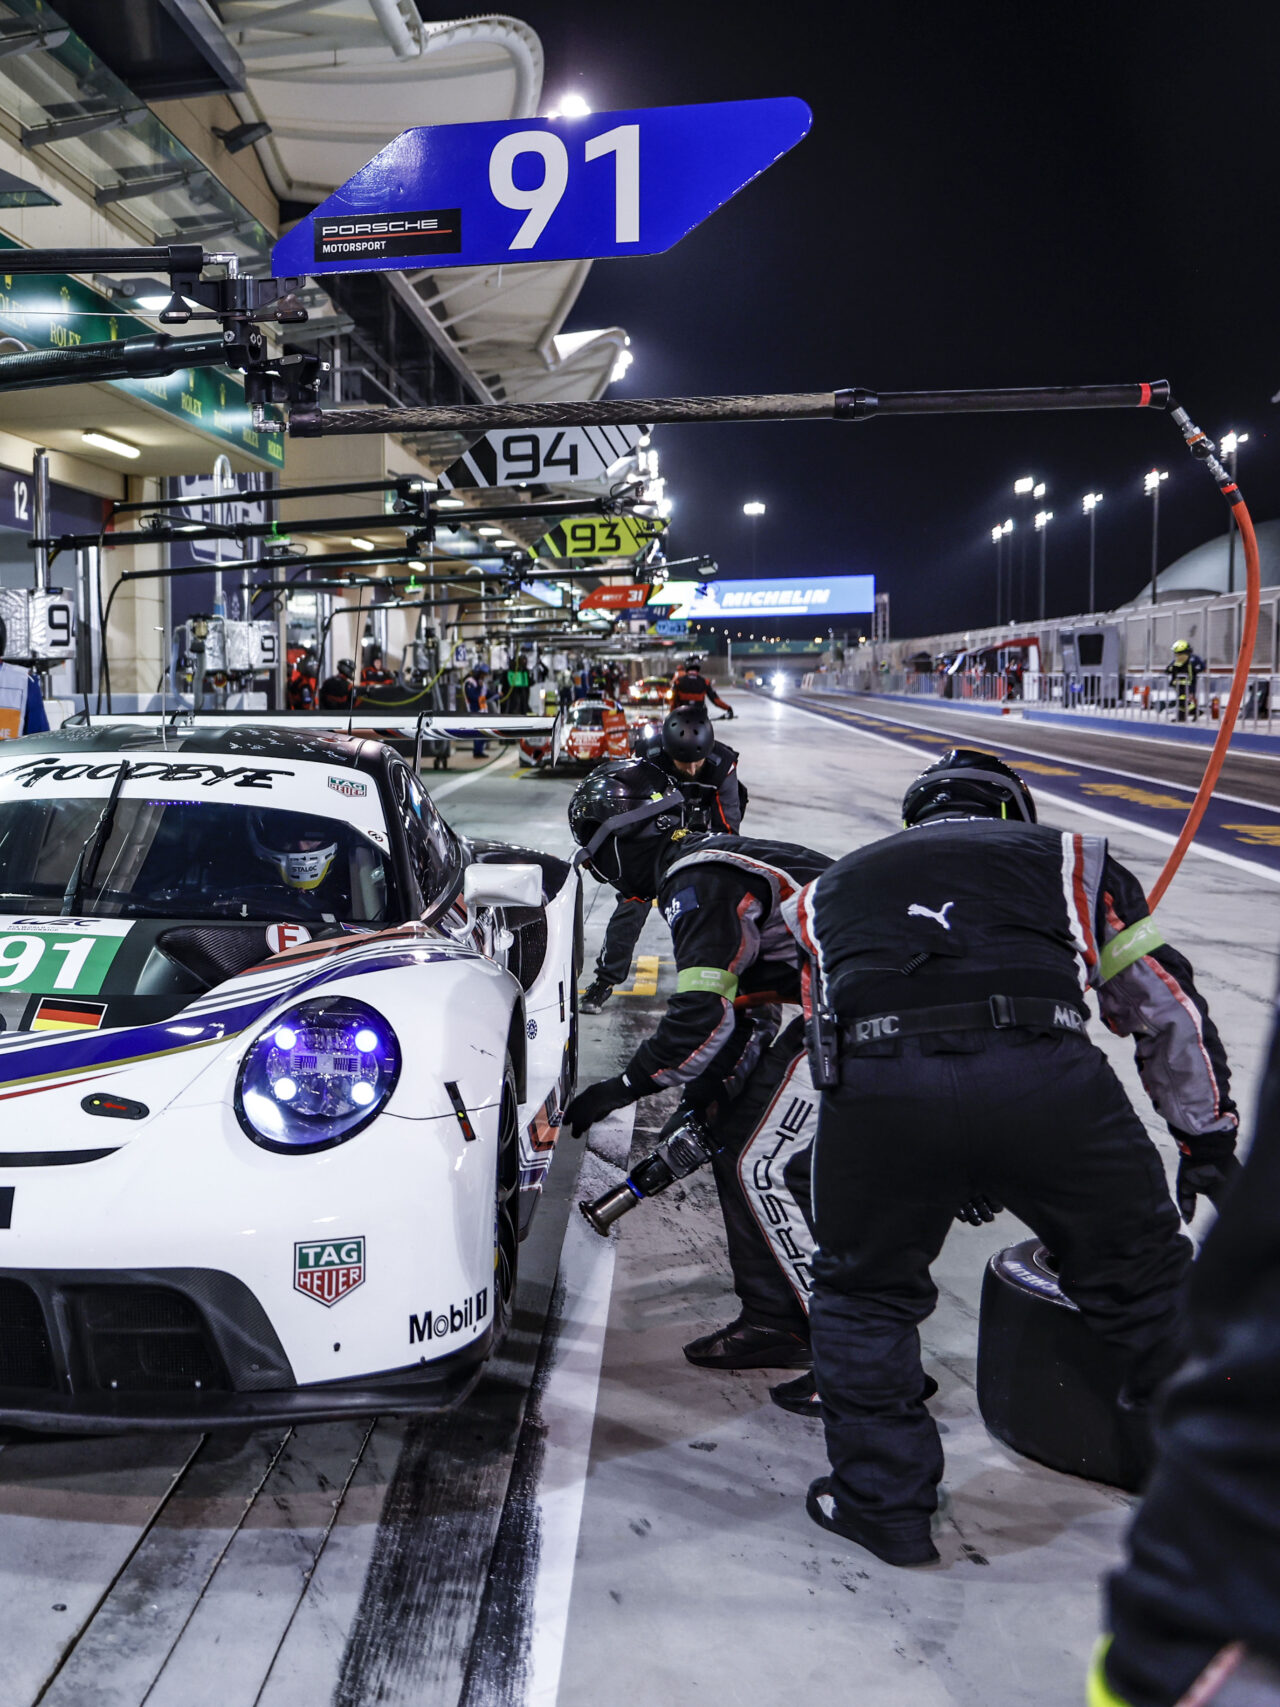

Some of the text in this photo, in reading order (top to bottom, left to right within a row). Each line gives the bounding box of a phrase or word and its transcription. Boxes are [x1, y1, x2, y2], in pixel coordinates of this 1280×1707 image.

[488, 124, 640, 251] 91
[322, 219, 438, 236] PORSCHE
[322, 241, 386, 254] MOTORSPORT
[50, 320, 82, 346] ROLEX
[181, 392, 202, 418] ROLEX
[267, 439, 283, 461] ROLEX
[503, 431, 579, 480] 94
[13, 481, 29, 521] 12
[570, 522, 622, 554] 93
[627, 589, 644, 603] 31
[722, 588, 831, 608] MICHELIN
[48, 604, 77, 647] 9
[261, 634, 278, 664] 9
[329, 783, 365, 797] HEUER
[330, 776, 366, 791] TAG
[291, 864, 318, 874] STALOC
[12, 917, 102, 927] WEC
[277, 925, 300, 953] E
[852, 1014, 900, 1042] RTC
[753, 1096, 814, 1292] ORSCHE
[302, 1243, 359, 1267] TAG
[299, 1267, 360, 1300] HEUER
[409, 1287, 488, 1345] Mobil 1
